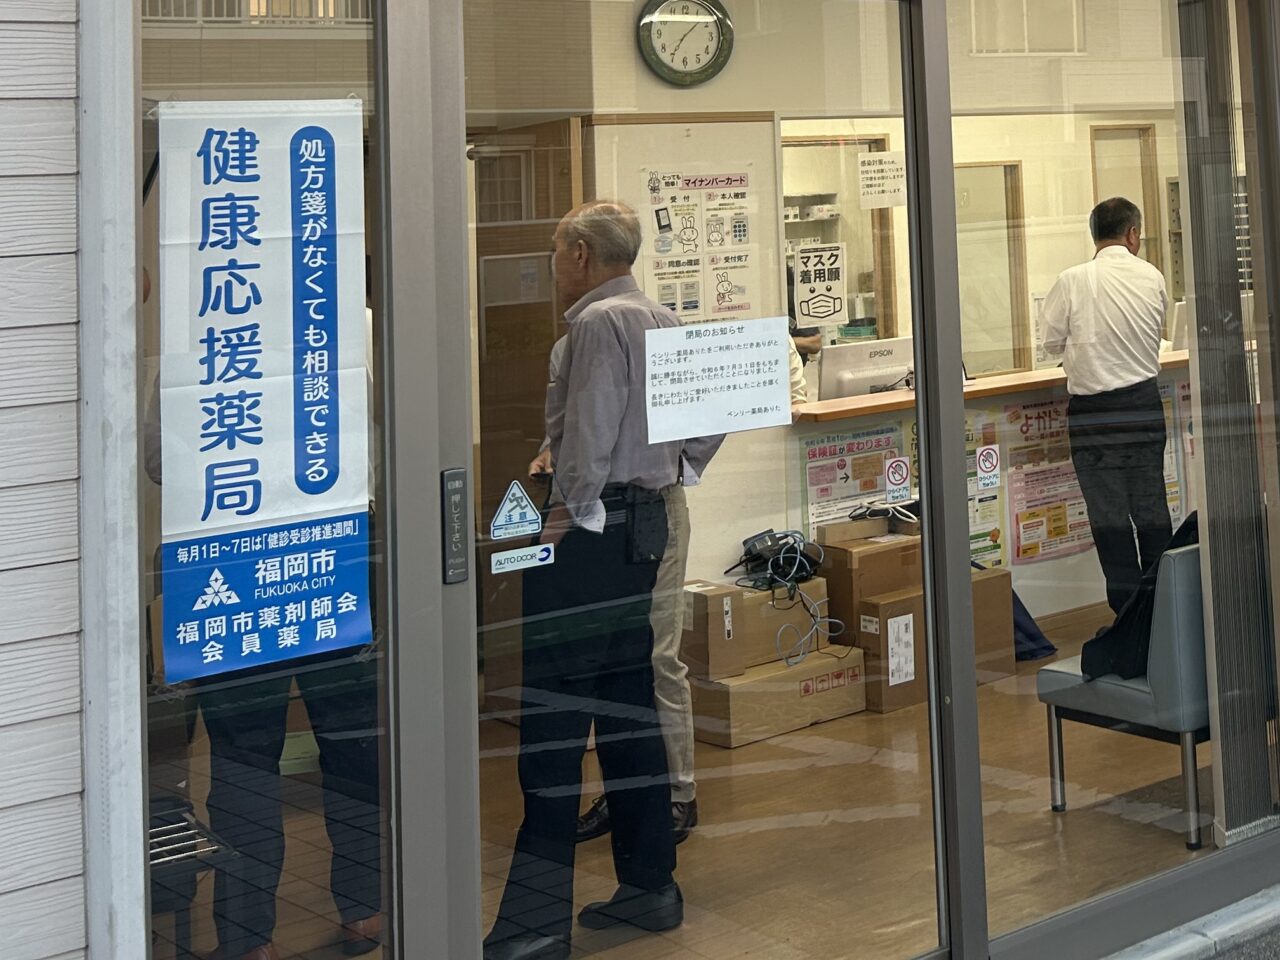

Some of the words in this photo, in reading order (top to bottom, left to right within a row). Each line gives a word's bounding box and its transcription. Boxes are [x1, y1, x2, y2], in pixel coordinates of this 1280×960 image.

[681, 5, 689, 15] 12
[656, 29, 662, 39] 9
[709, 32, 714, 41] 3
[661, 43, 666, 53] 8
[705, 45, 710, 55] 4
[670, 53, 675, 63] 7
[682, 56, 688, 68] 6
[696, 54, 701, 64] 5
[684, 176, 745, 187] マイナンバーカード
[800, 253, 839, 268] マスク
[299, 138, 330, 483] 処方箋がなくても相談できる
[196, 127, 264, 522] 健康応援薬局
[686, 325, 745, 340] 閉局のお知らせ
[869, 348, 893, 358] EPSON
[652, 357, 692, 367] うございます。
[451, 494, 462, 552] 押して下さい
[495, 556, 516, 567] AUTO
[516, 552, 537, 563] DOOR
[254, 549, 337, 586] 福岡市
[254, 581, 309, 600] FUKUOKA
[311, 575, 337, 590] CITY
[176, 591, 358, 645] 福岡市薬剤師会
[202, 618, 337, 664] 会員薬局
